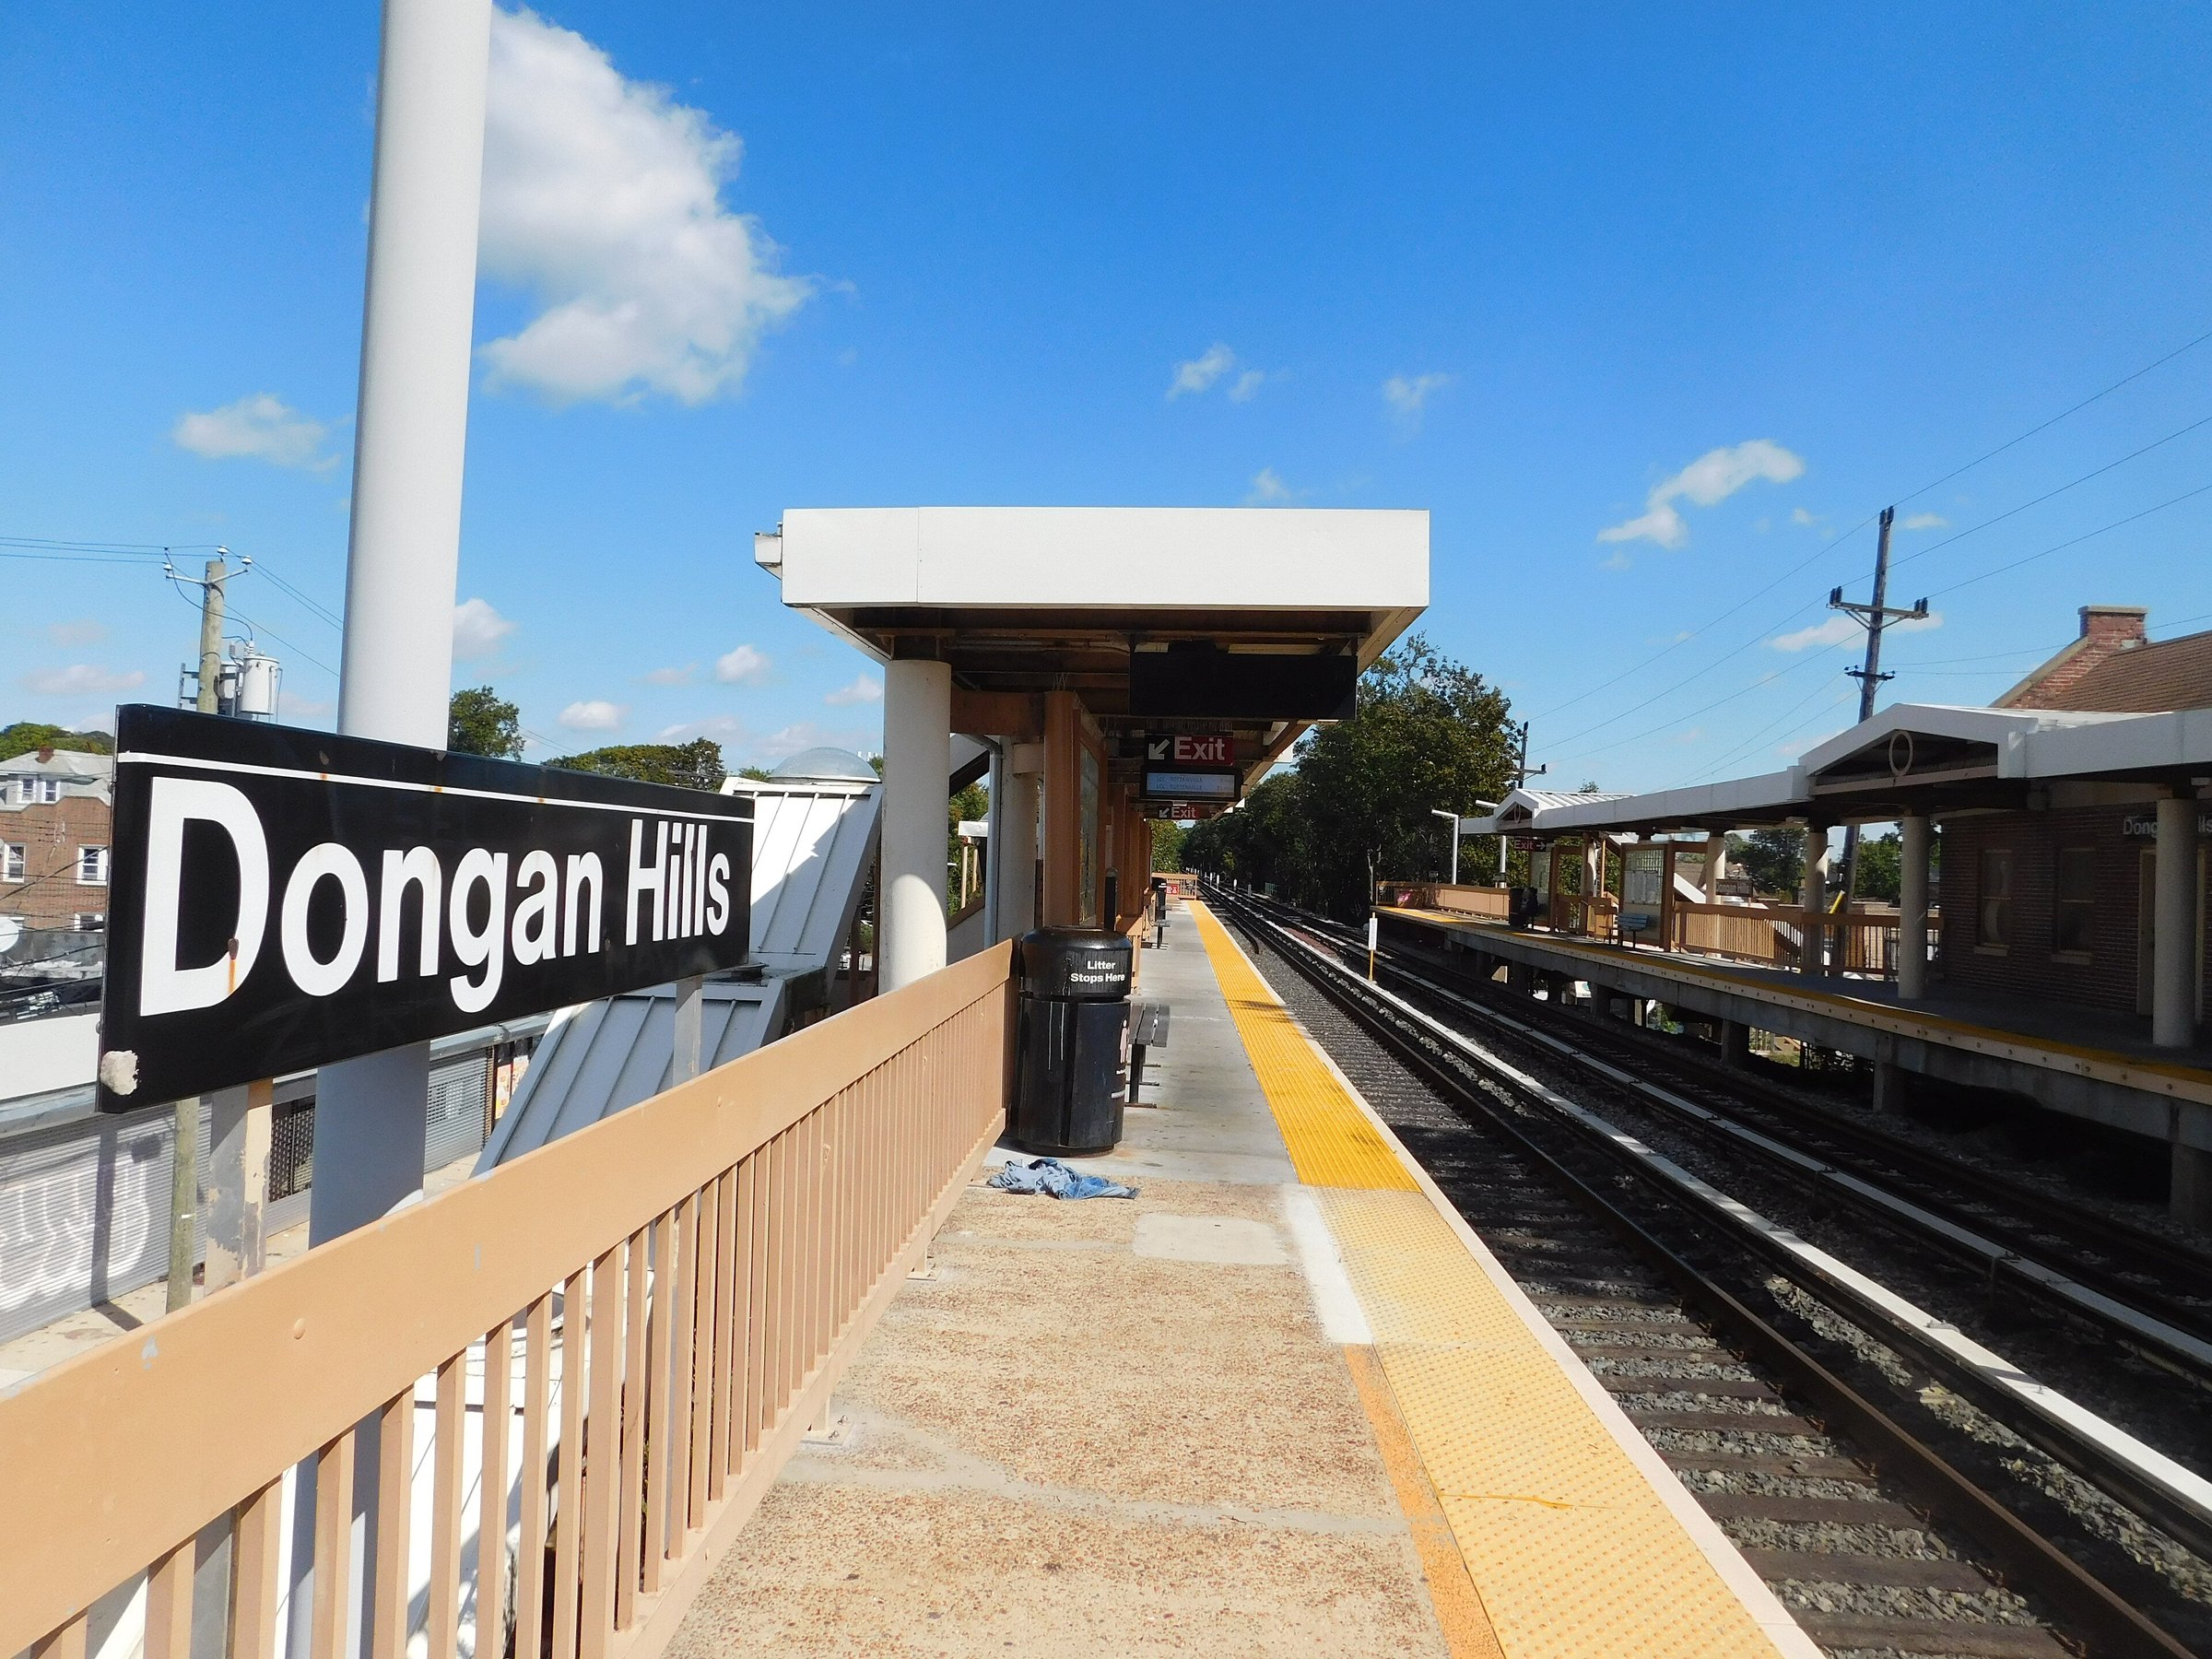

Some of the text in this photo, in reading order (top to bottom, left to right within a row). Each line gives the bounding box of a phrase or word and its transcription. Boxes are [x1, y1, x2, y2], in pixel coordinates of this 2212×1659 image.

[1174, 736, 1225, 760] Exit
[1171, 807, 1196, 818] Exit
[1513, 840, 1534, 850] Exit
[139, 776, 731, 1016] Dongan Hills
[1087, 960, 1116, 970] Litter
[1070, 972, 1125, 983] Stops Here
